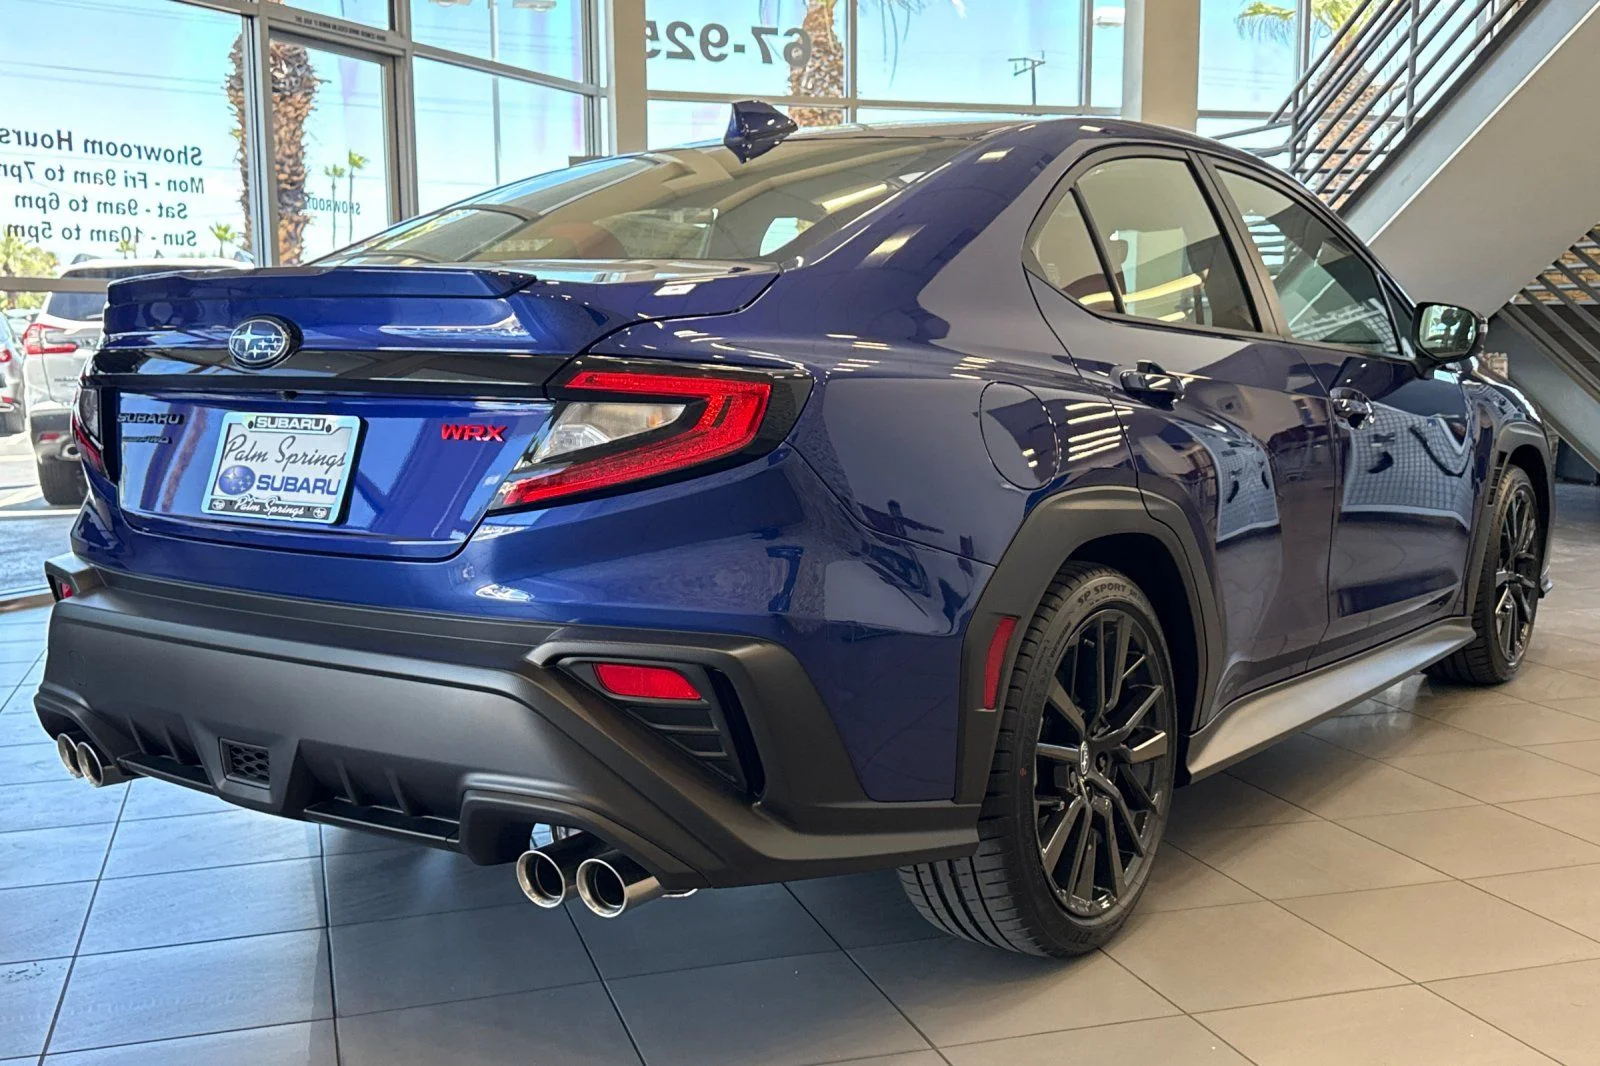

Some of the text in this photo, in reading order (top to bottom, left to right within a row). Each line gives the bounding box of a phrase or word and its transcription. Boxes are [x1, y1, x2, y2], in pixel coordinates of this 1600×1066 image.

[118, 413, 183, 425] SUBARU
[256, 417, 324, 430] SUBARU
[442, 424, 507, 442] WRX
[224, 434, 346, 475] Palm Springs
[256, 474, 341, 495] SUBARU
[233, 495, 304, 517] Palm Springs
[1077, 583, 1126, 605] SP SPORT
